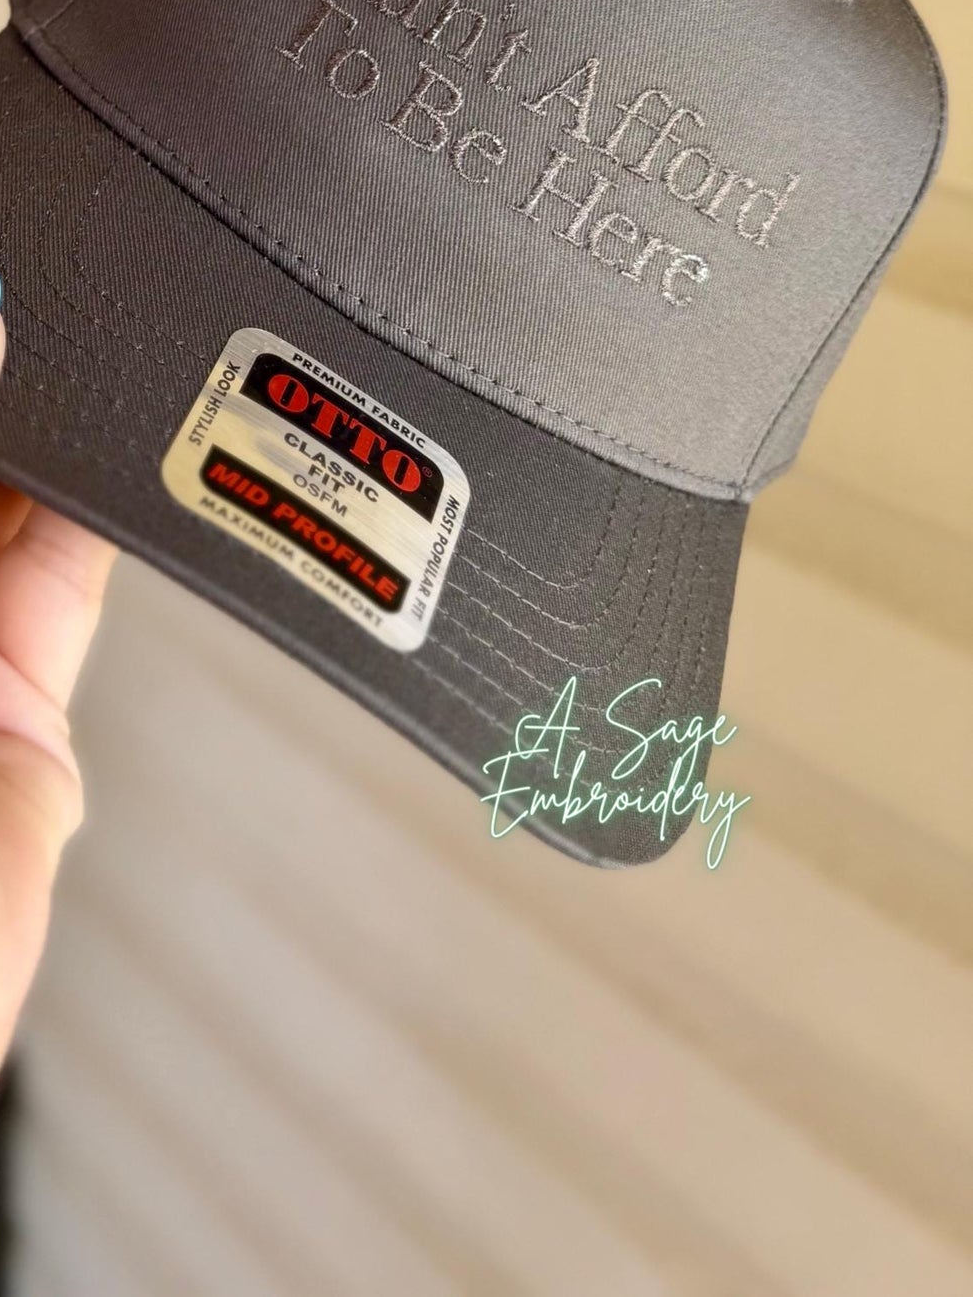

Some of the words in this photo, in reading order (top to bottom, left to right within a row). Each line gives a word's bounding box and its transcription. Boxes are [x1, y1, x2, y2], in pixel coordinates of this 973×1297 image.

[378, 59, 507, 185] Be
[507, 144, 710, 308] Here
[521, 57, 802, 249] Afford
[188, 396, 223, 447] STYLISH
[217, 360, 242, 399] LOOK
[267, 373, 422, 494] OTTO
[292, 352, 367, 407] PREMIUM
[371, 403, 428, 450] FABRIC
[284, 432, 380, 503] CLASSIC
[292, 473, 349, 518] OSFM
[307, 464, 347, 494] FIT
[208, 462, 271, 508] MID
[273, 501, 400, 602] PROFILE
[439, 494, 461, 536] MOST
[199, 495, 296, 562] MAXIMUM
[299, 559, 384, 629] COMFORT
[417, 533, 450, 604] POPULAR
[411, 599, 428, 623] FIT
